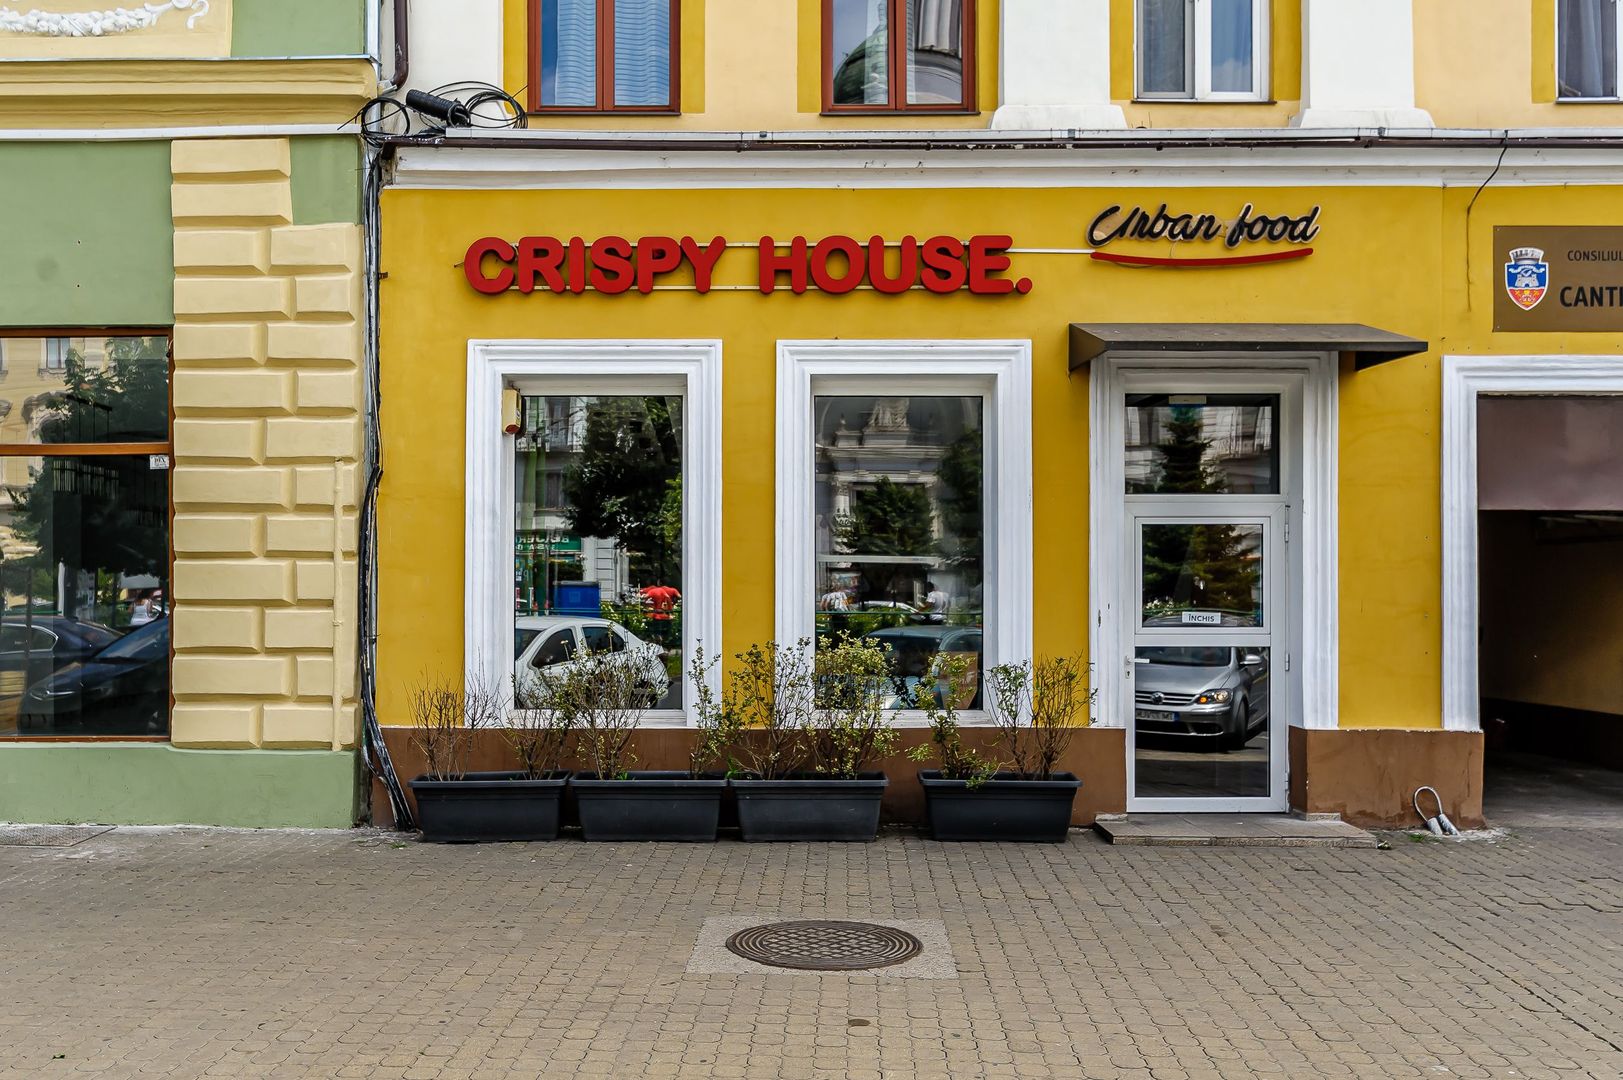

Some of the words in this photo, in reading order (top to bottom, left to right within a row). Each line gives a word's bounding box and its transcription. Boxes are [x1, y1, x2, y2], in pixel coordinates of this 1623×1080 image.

[1088, 203, 1223, 247] Urban
[1224, 203, 1321, 248] food
[464, 236, 726, 294] CRISPY
[759, 235, 1032, 294] HOUSE.
[1567, 250, 1623, 261] CONSILIUL
[1188, 613, 1215, 622] ÎNCHIS
